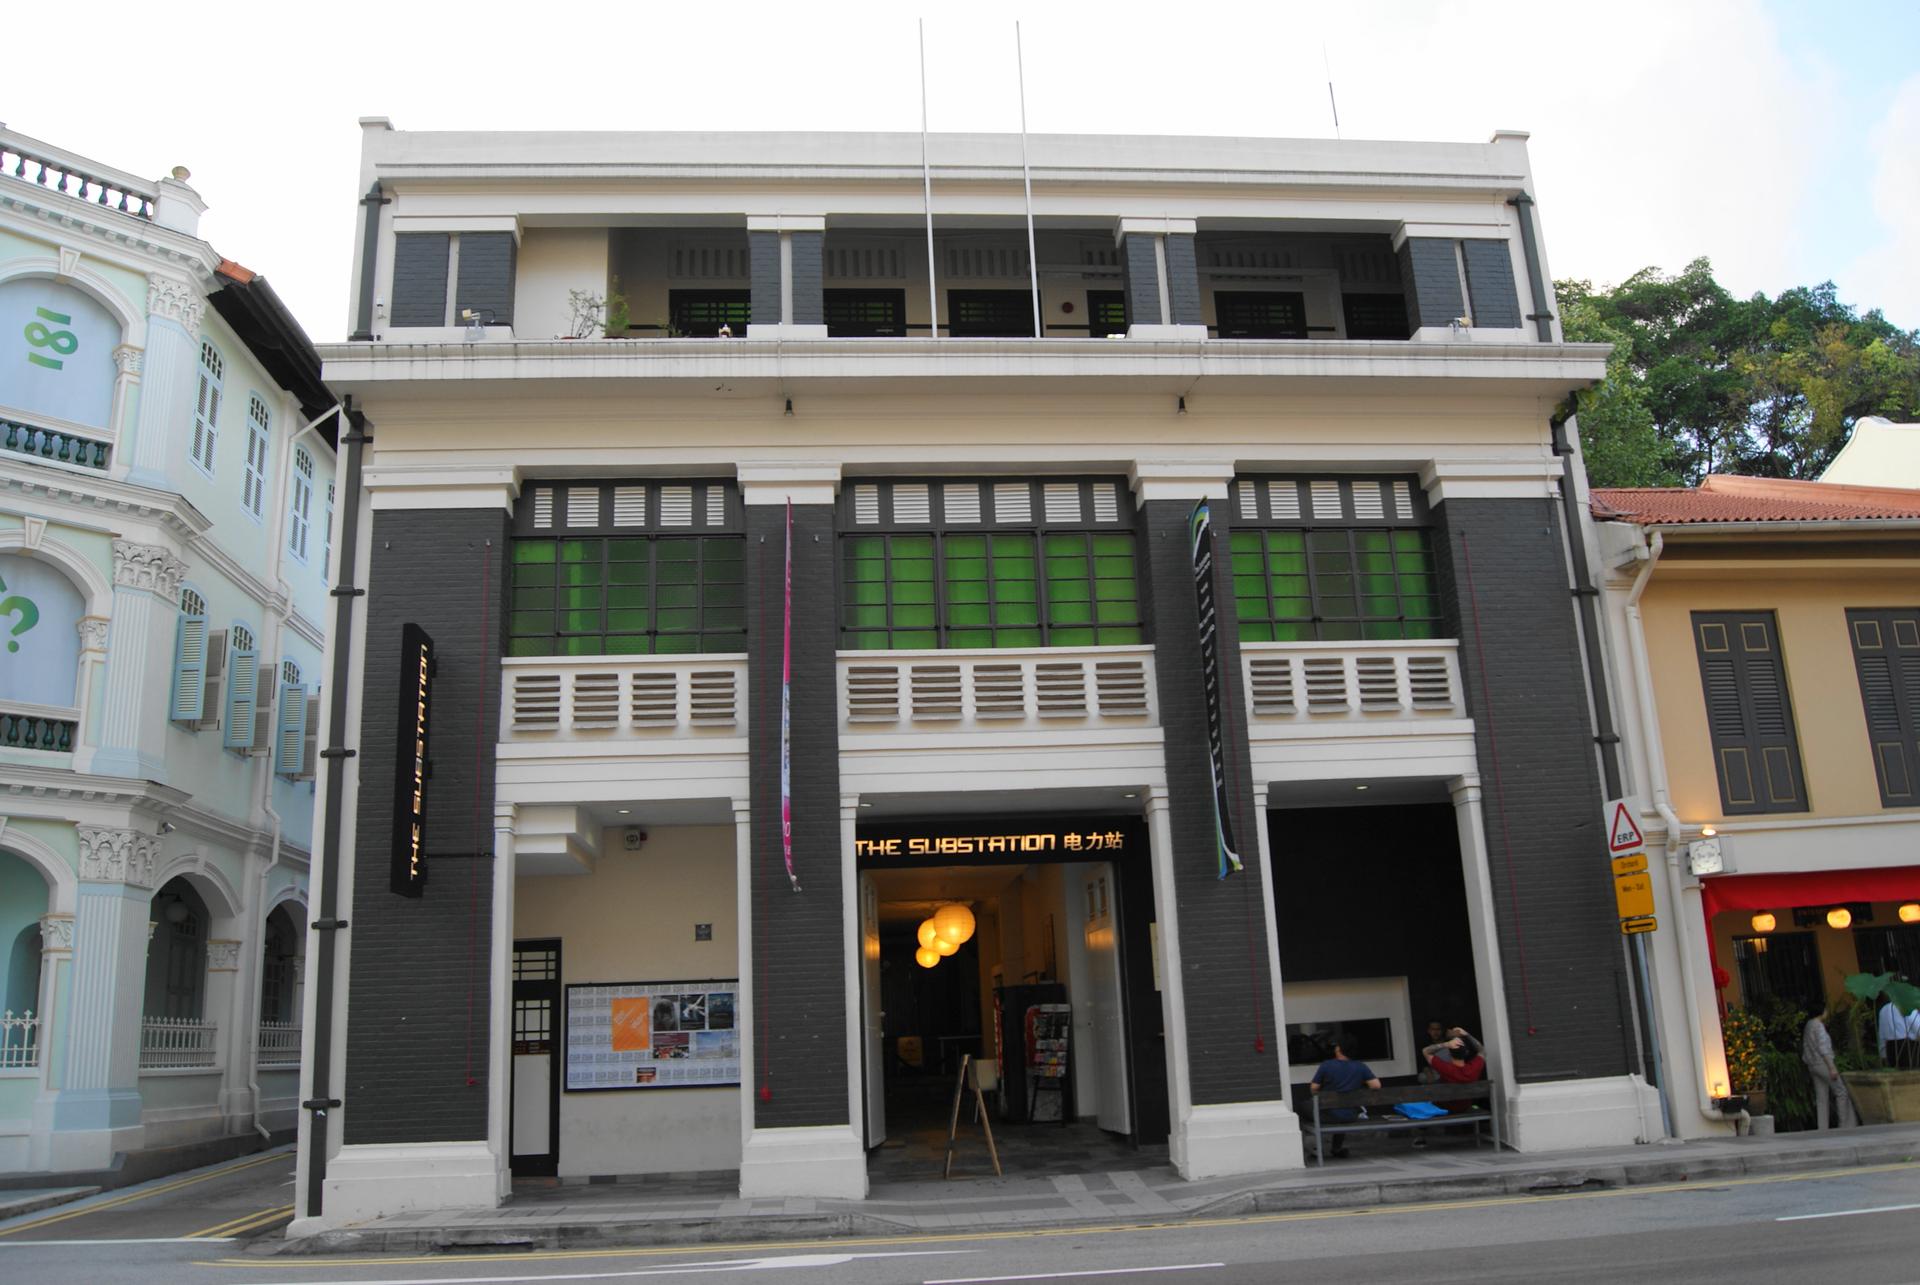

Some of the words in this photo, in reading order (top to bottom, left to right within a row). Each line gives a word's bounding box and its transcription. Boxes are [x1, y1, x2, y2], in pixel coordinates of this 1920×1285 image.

[412, 643, 428, 816] SUBSTATION
[410, 822, 420, 881] THE
[855, 839, 902, 856] THE
[908, 834, 1056, 855] SUBSTATION
[1063, 831, 1125, 851] 电力站
[1617, 831, 1634, 844] ERP
